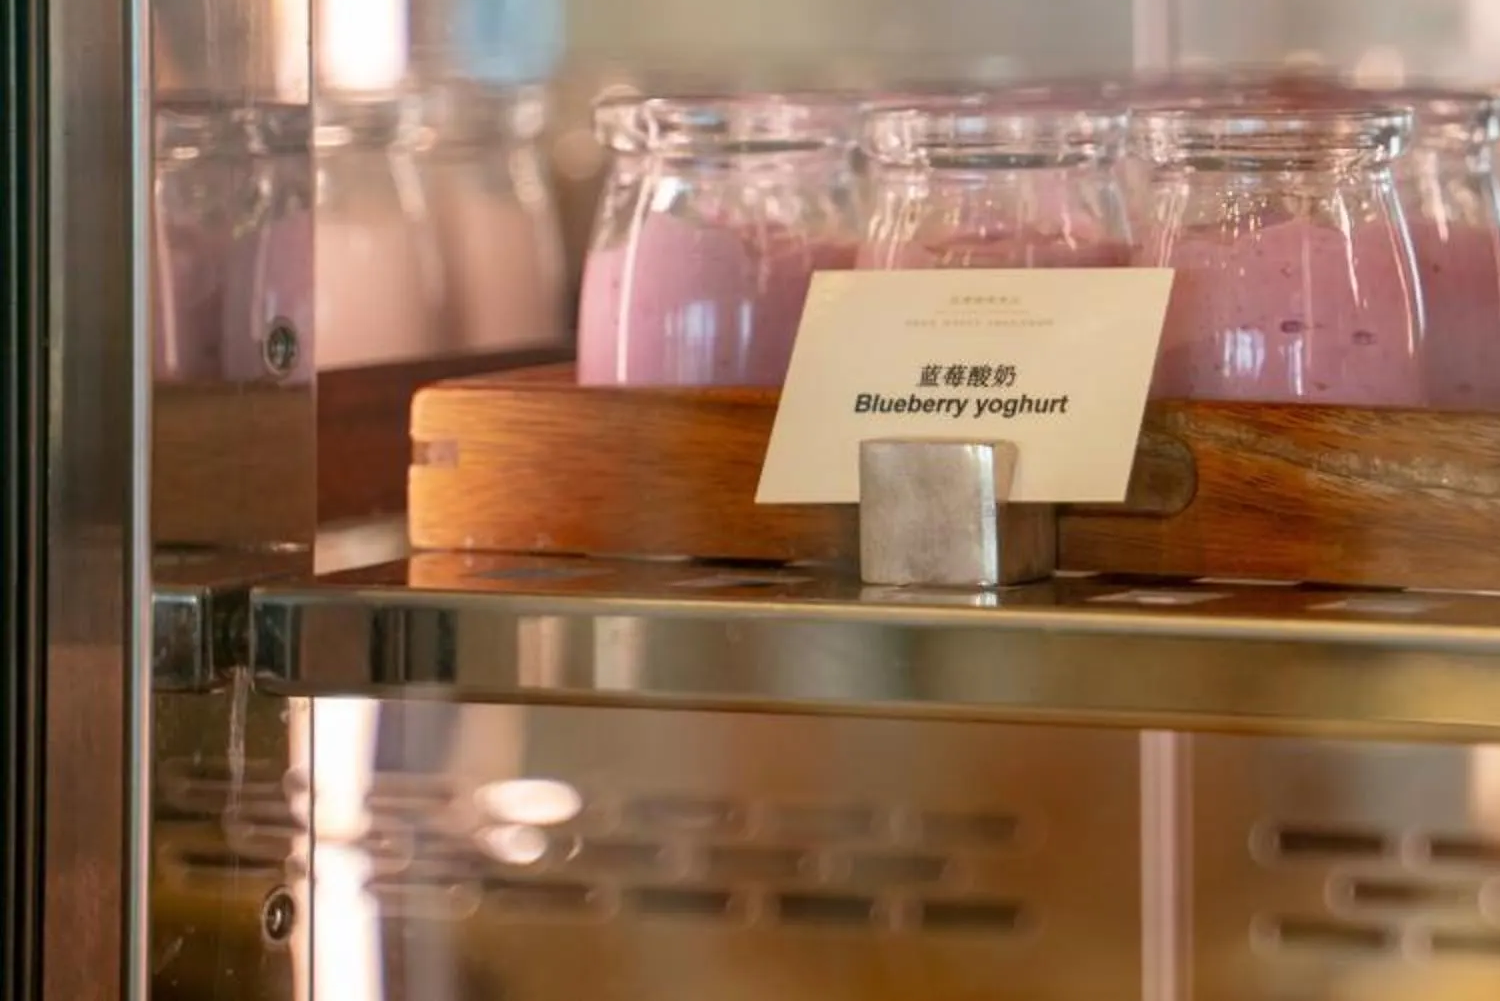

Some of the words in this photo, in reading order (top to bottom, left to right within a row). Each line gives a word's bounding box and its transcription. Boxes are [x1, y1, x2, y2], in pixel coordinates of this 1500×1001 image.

[917, 364, 1017, 388] 蓝莓酸奶
[854, 393, 968, 418] Blueberry
[973, 394, 1068, 418] yoghurt
